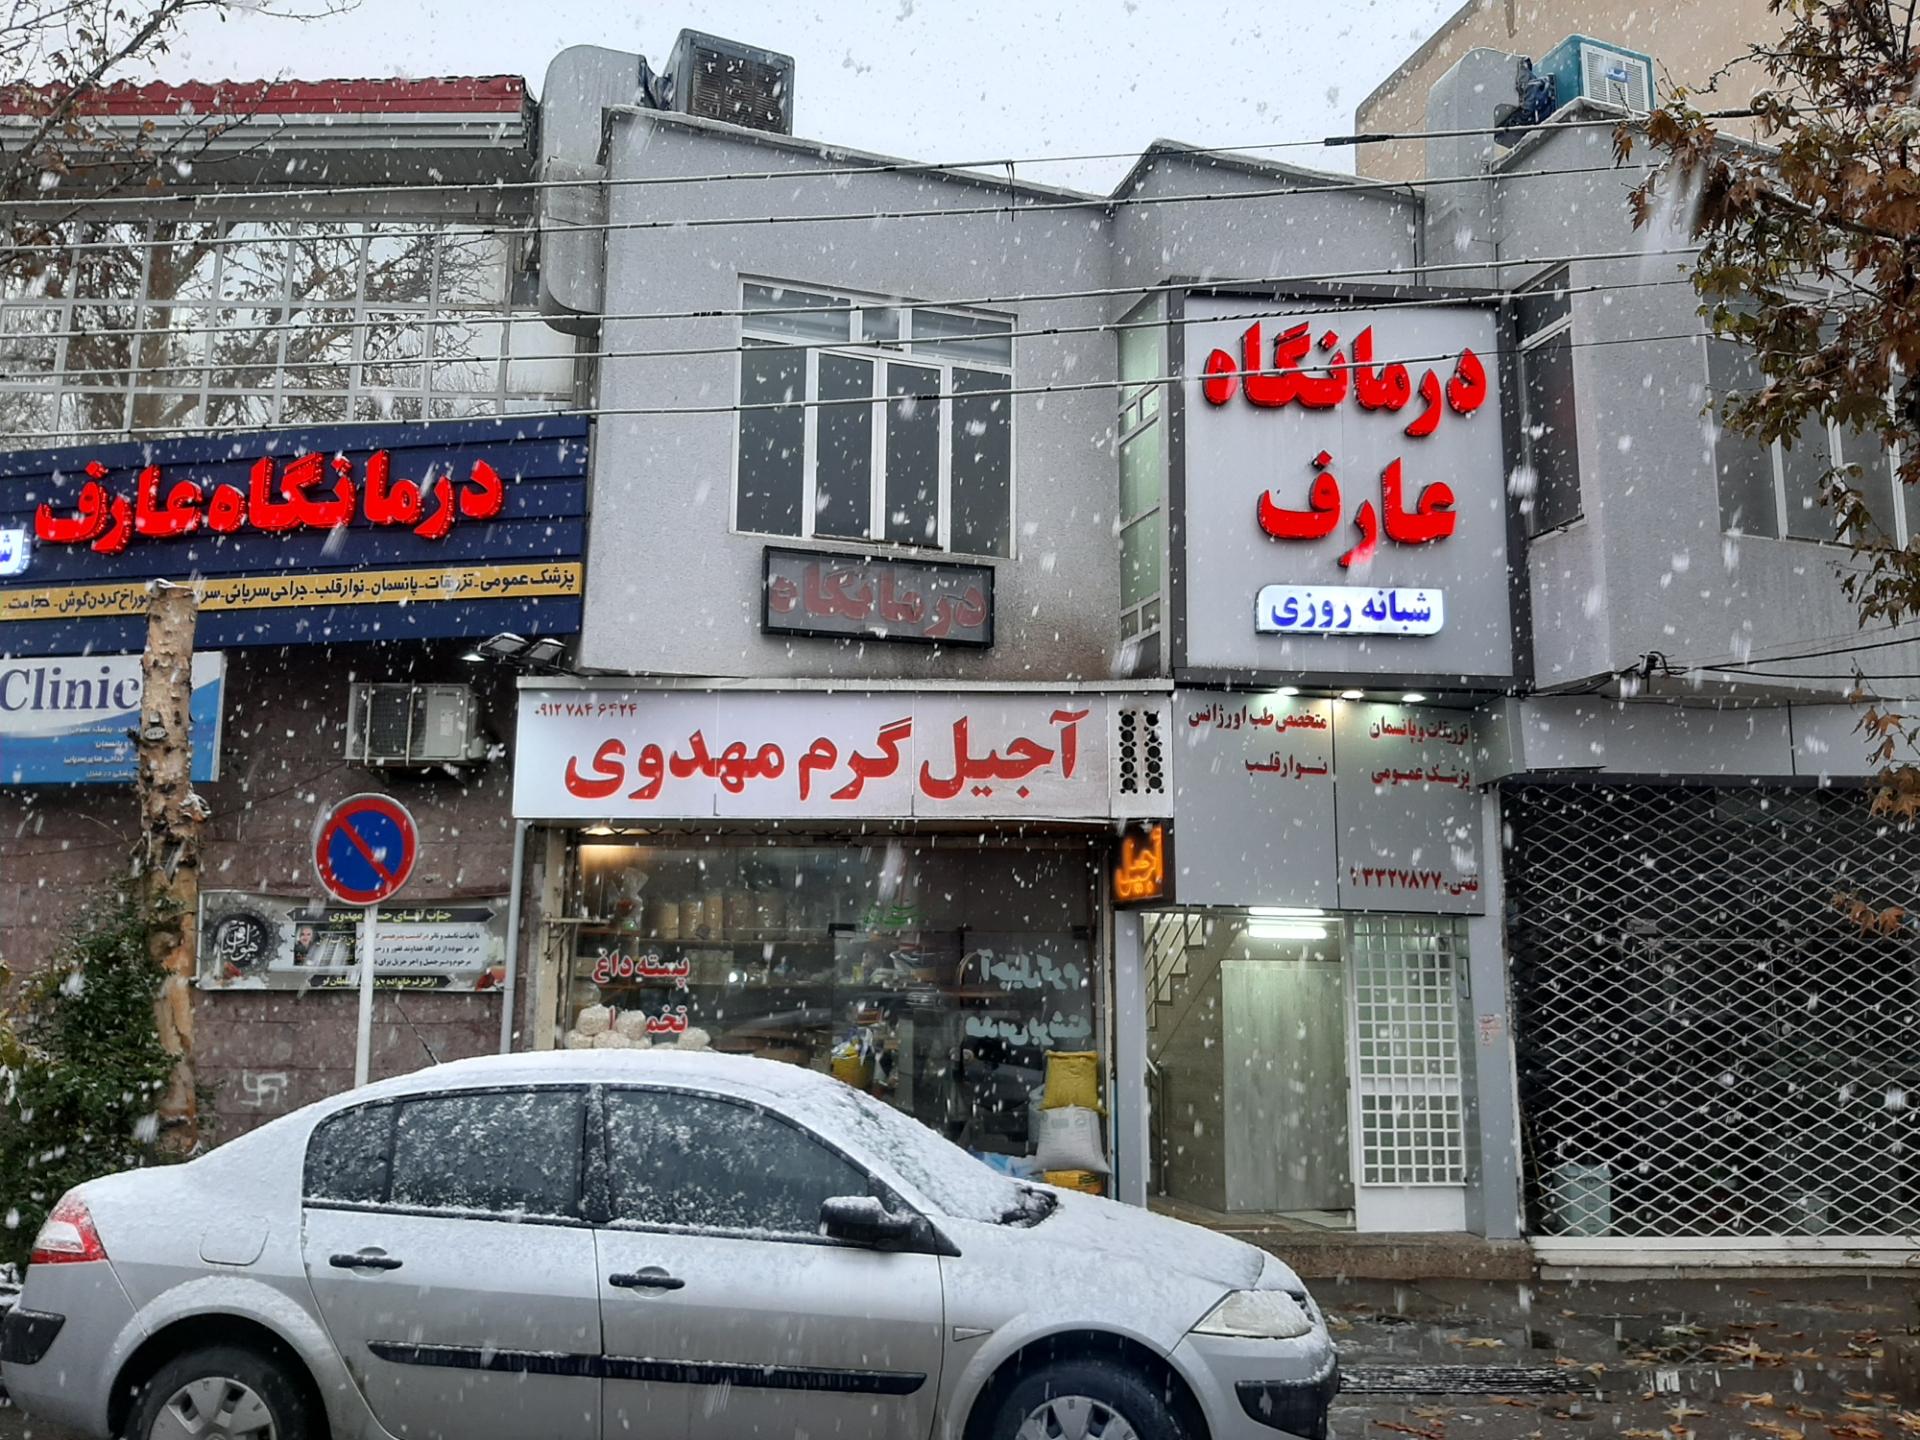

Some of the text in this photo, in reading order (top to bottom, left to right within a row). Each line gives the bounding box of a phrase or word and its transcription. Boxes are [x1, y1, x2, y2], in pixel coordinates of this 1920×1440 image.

[1202, 320, 1488, 437] درمانگاه
[35, 450, 504, 554] درمانگاه عارف
[1257, 449, 1457, 569] عارف
[270, 580, 308, 601] جراحی
[371, 574, 418, 596] پانسمان
[480, 573, 528, 592] عمومی
[531, 567, 575, 590] پزشک
[59, 590, 90, 613] گوش
[88, 591, 121, 610] کردن
[768, 563, 988, 638] درمانگاه
[1271, 590, 1432, 631] شبانه روزی
[0, 666, 140, 712] Clinic
[1188, 702, 1327, 733] متخصص طب اورژانس
[1368, 715, 1417, 743] پانسمان
[563, 709, 1090, 801] آجیل گرم مهدوی
[1245, 751, 1328, 779] نوار قلب
[1370, 763, 1471, 791] پزشک عمومی
[1113, 825, 1165, 901] آجیل
[591, 949, 690, 987] پسته داغ
[646, 1005, 689, 1033] تخم
